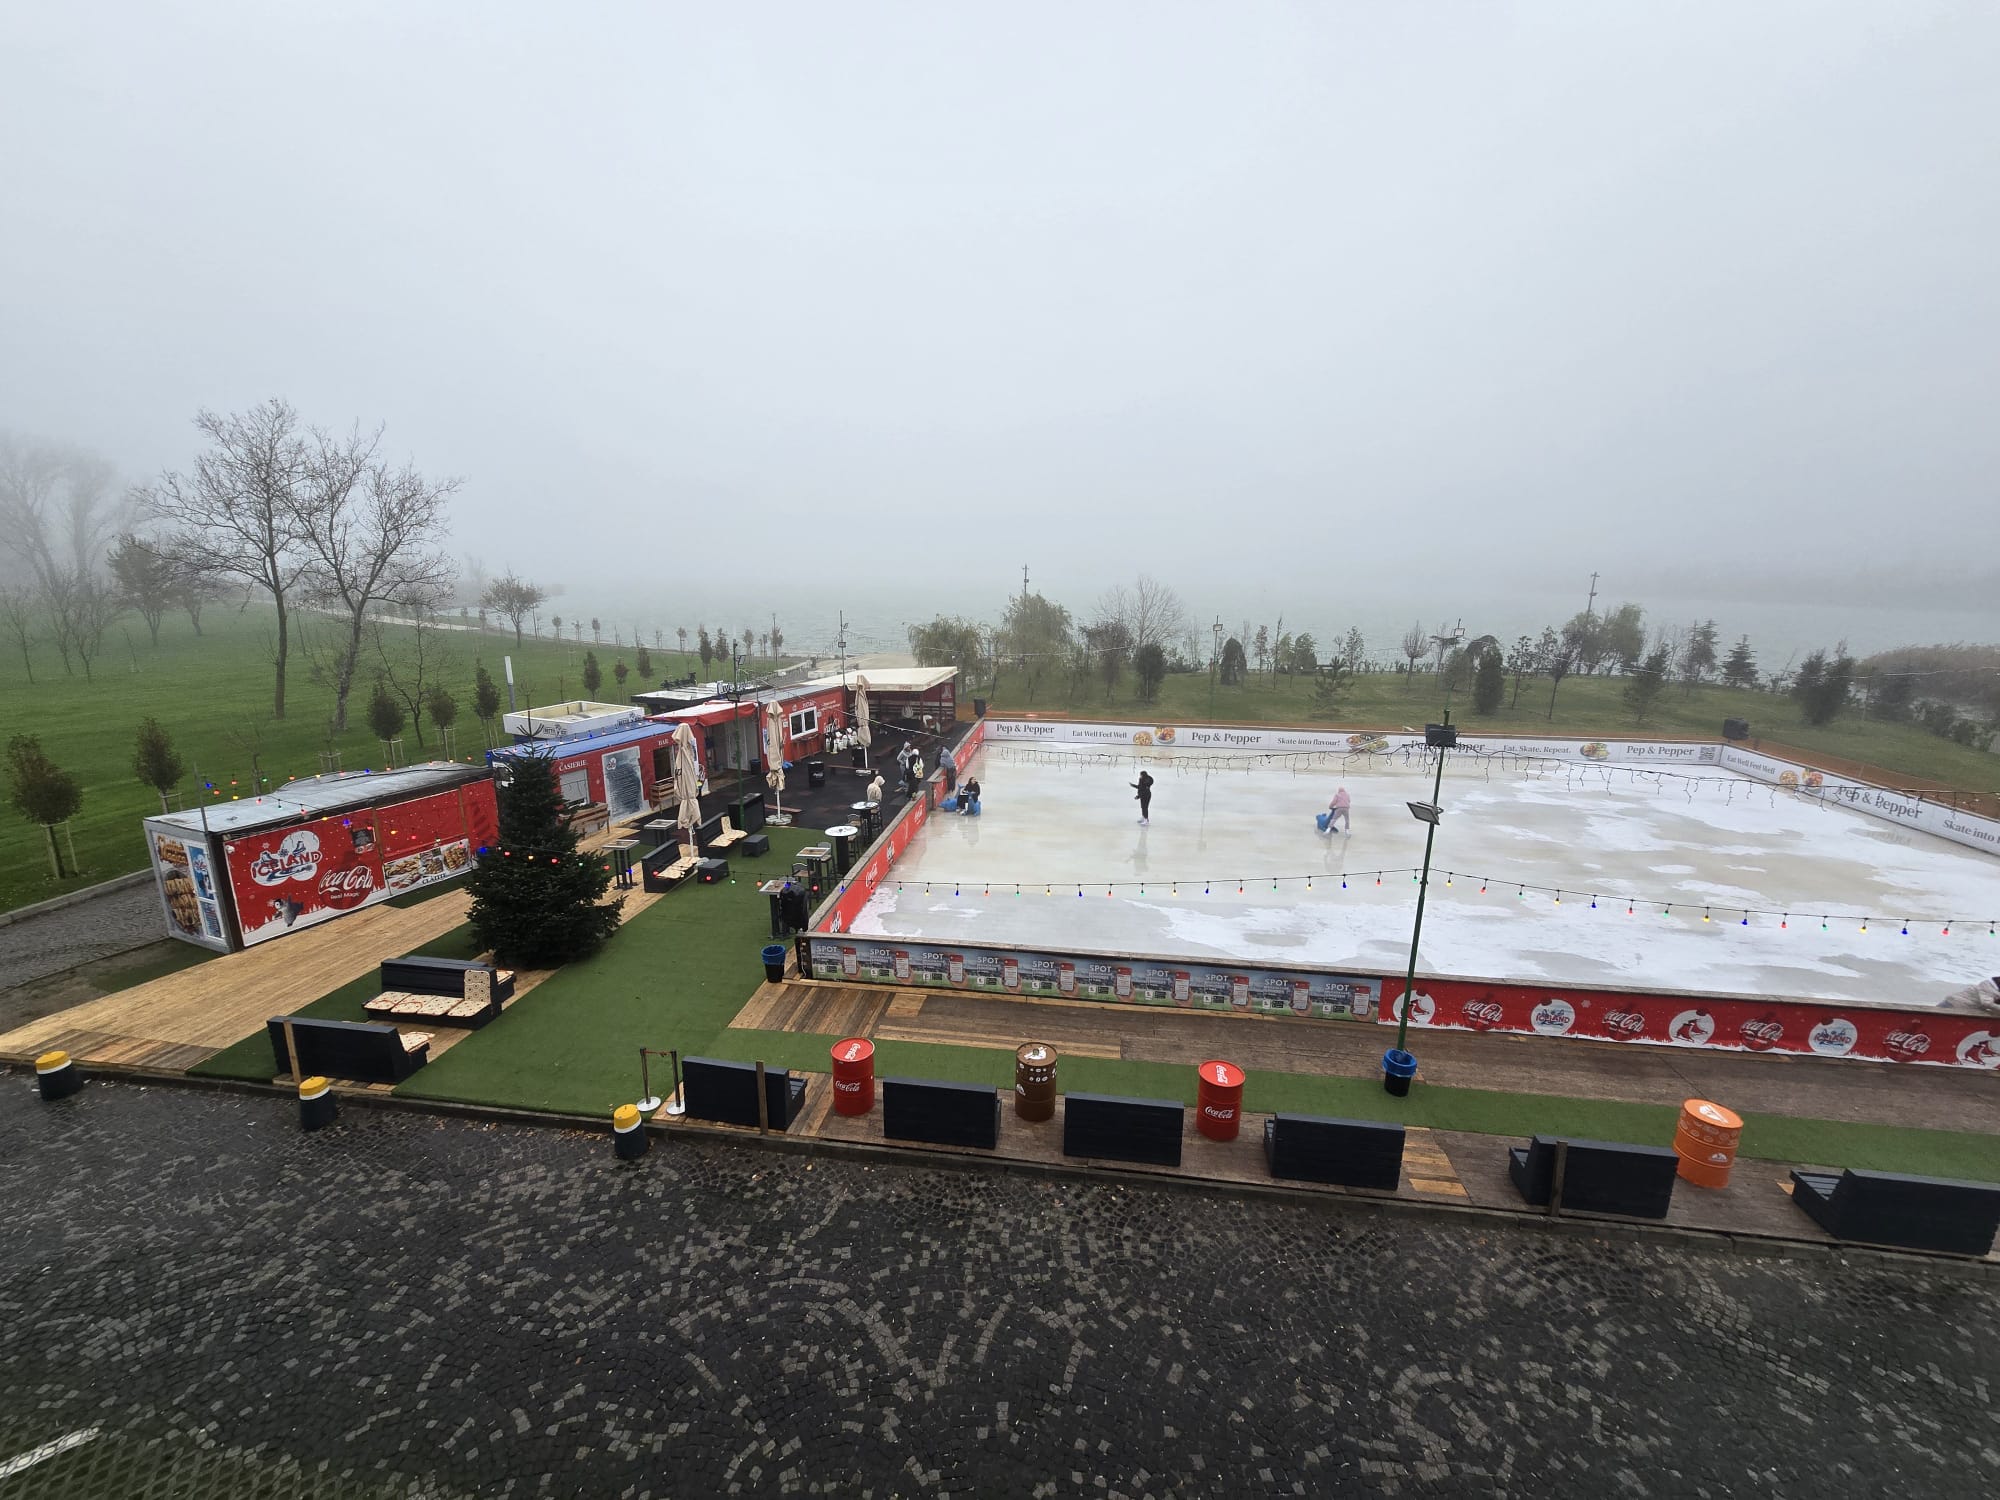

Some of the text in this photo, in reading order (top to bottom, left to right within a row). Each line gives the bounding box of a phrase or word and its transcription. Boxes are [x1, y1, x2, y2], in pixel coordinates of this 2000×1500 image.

[996, 724, 1054, 736] Pep & Pepper
[1192, 732, 1262, 744] Pep & Pepper
[1277, 737, 1297, 745] Skate
[1626, 745, 1695, 758] Pep & Pepper
[1838, 784, 1922, 820] Pep & Pepper
[1943, 819, 1972, 835] Skate
[1973, 828, 1995, 844] into
[251, 850, 322, 878] ICELAND
[318, 865, 374, 895] Coca-Cola
[816, 945, 838, 953] SPOT
[922, 952, 944, 960] SPOT
[976, 956, 999, 964] SPOT
[1032, 960, 1055, 969] SPOT
[1088, 964, 1112, 973] SPOT
[1146, 969, 1169, 978] SPOT
[1205, 974, 1229, 982] SPOT
[1264, 978, 1289, 987] SPOT
[1325, 983, 1350, 992] SPOT
[836, 1080, 861, 1092] Coca-Cola
[1204, 1106, 1234, 1119] Coca-Cola
